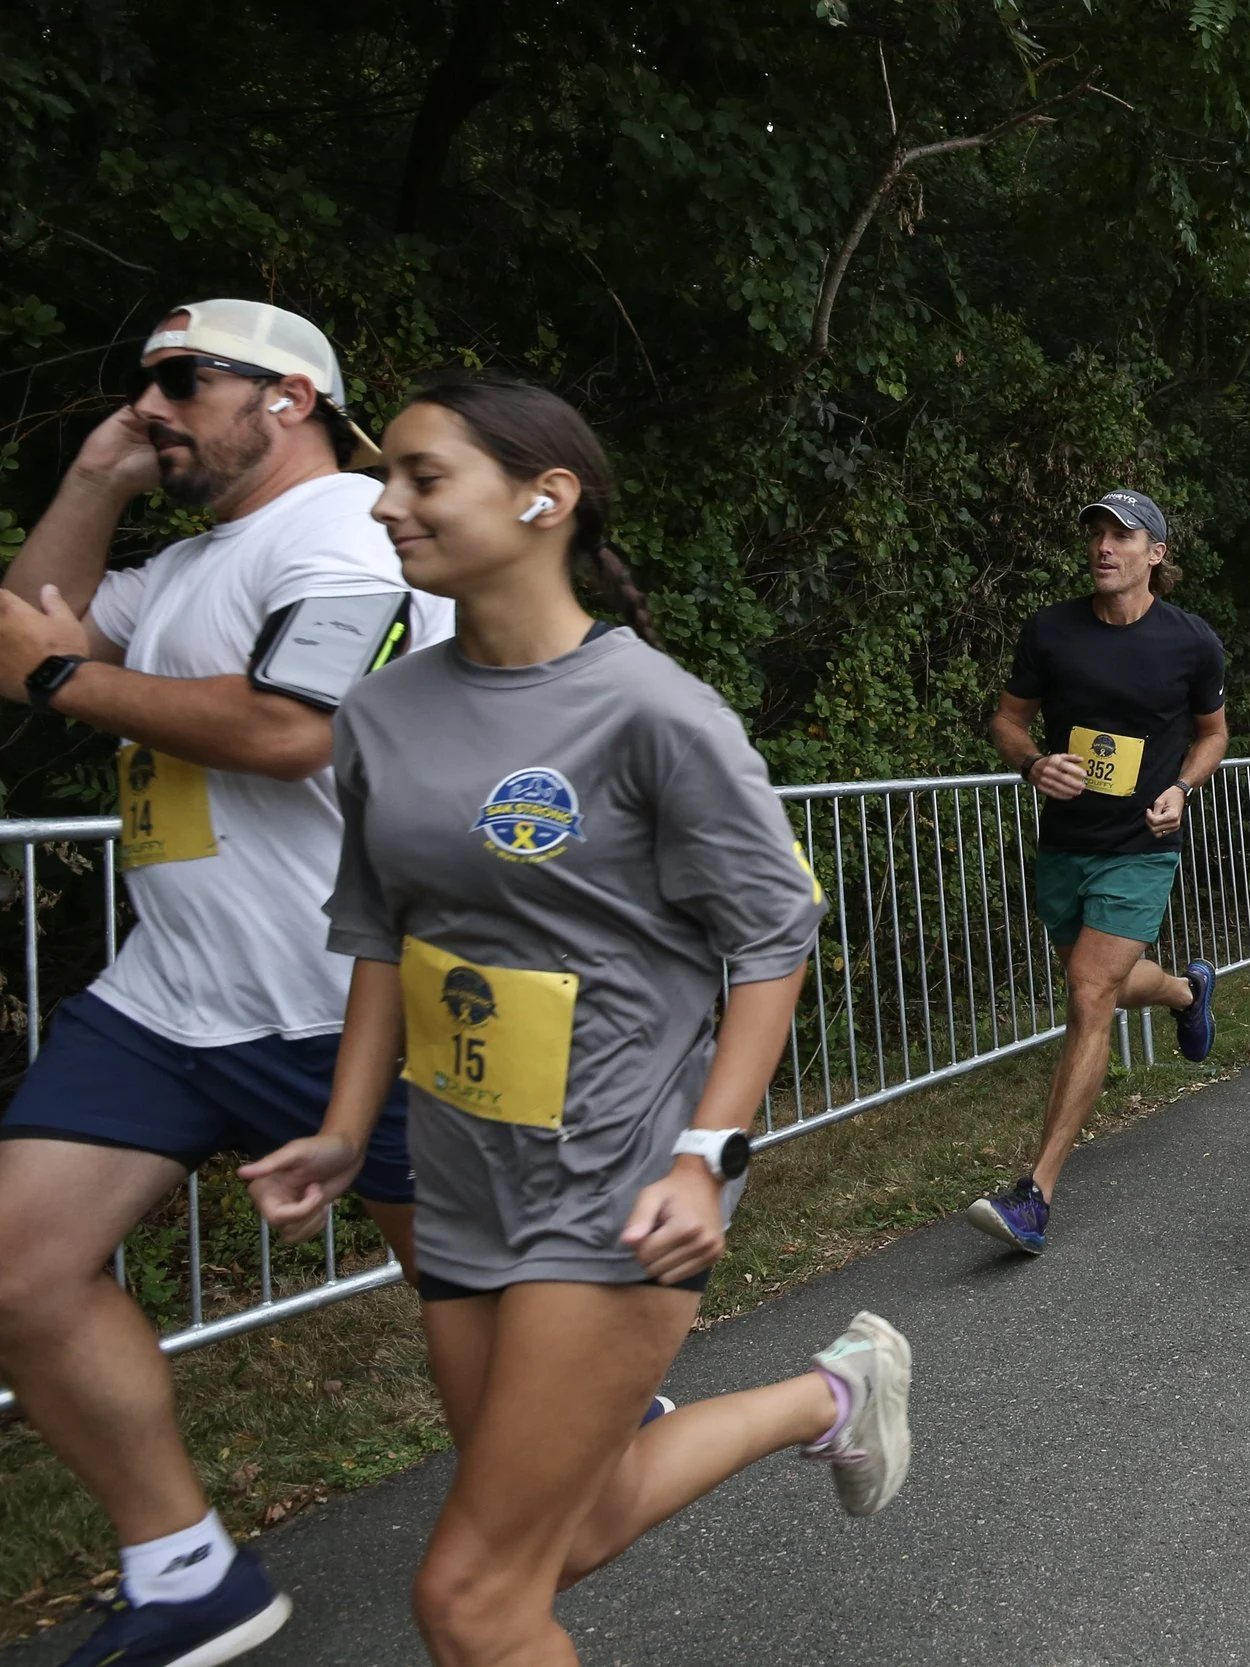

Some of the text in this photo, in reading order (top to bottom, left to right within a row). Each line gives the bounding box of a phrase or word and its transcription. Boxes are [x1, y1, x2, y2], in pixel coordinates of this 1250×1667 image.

[1087, 759, 1115, 781] 352
[130, 800, 152, 839] 14
[452, 1033, 485, 1082] 15
